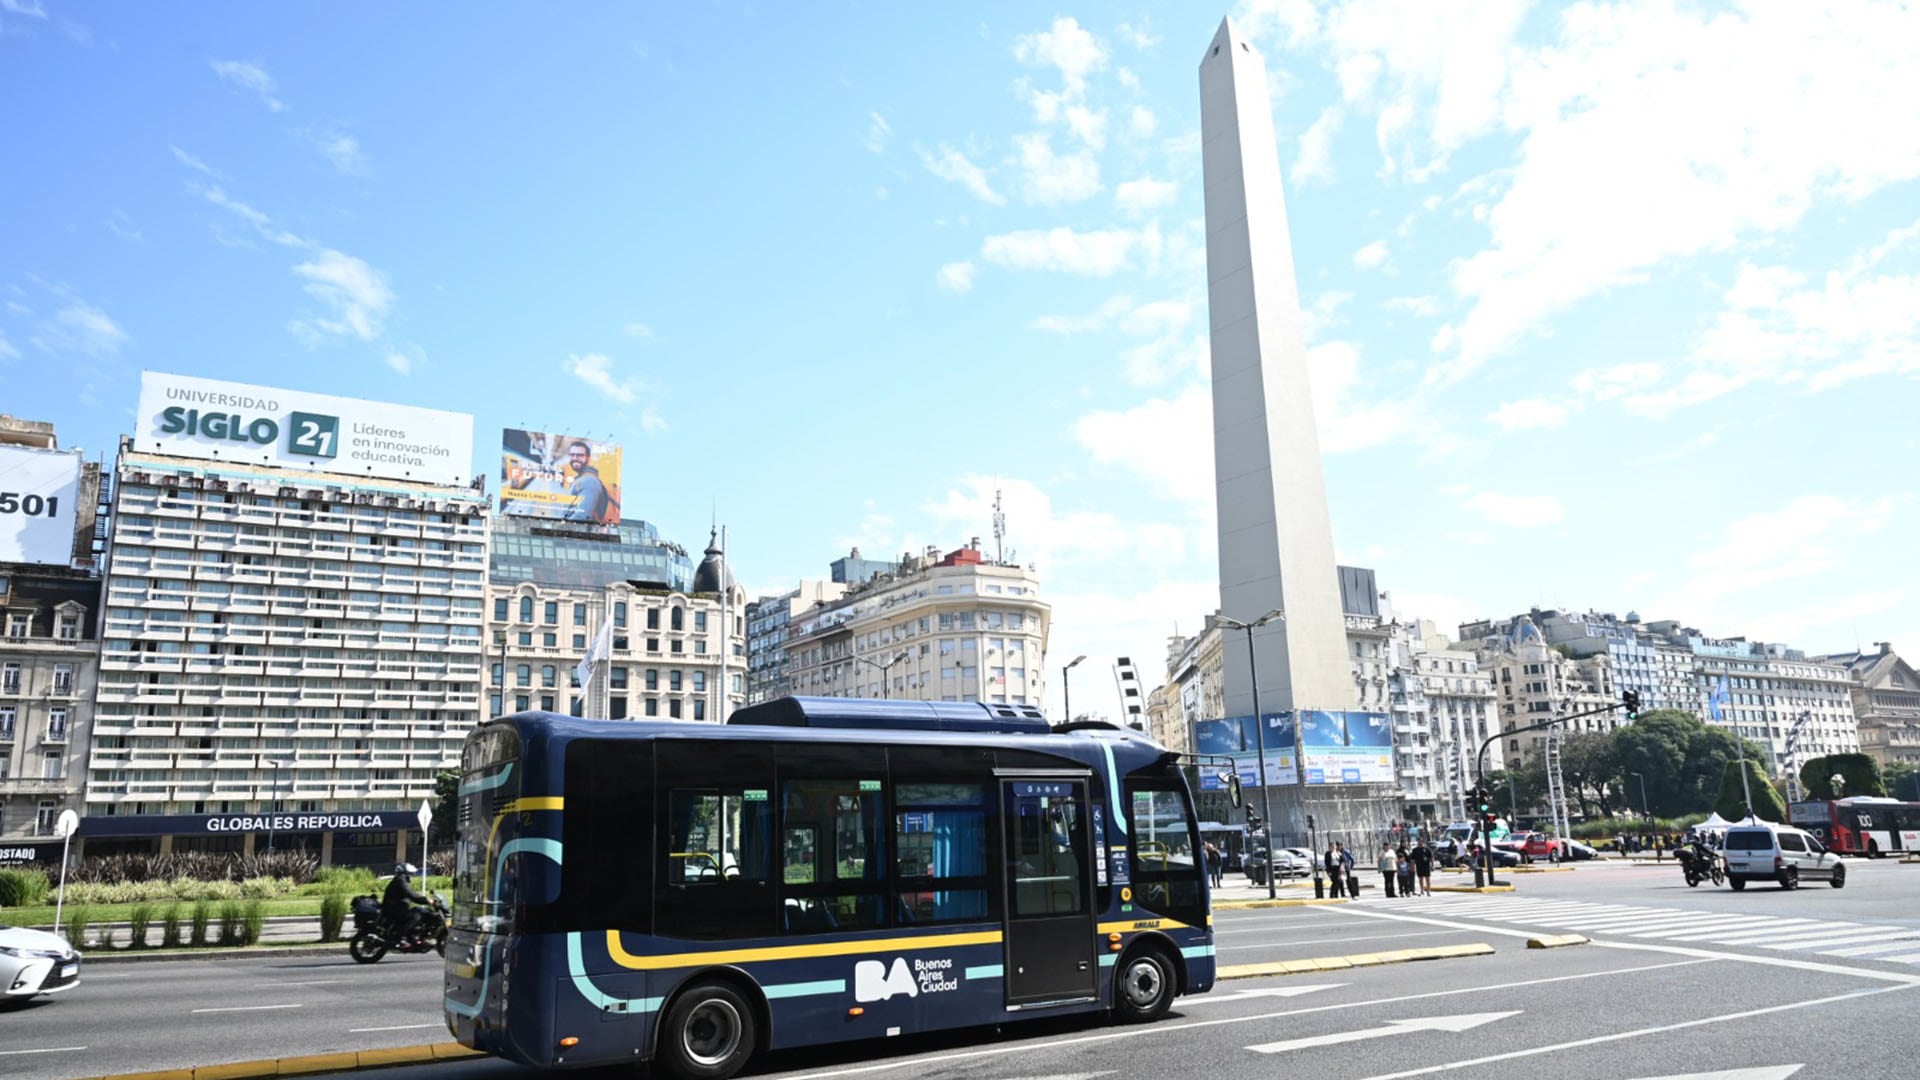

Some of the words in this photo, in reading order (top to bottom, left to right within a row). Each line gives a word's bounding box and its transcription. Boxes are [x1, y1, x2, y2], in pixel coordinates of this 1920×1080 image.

[166, 387, 279, 412] UNIVERSIDAD
[161, 406, 279, 445] SIGLO
[296, 421, 332, 456] 21
[353, 423, 406, 439] Líderes
[352, 438, 370, 447] en
[374, 438, 450, 457] innovación
[351, 450, 425, 467] educativa.
[0, 492, 58, 518] 501
[207, 817, 294, 831] GLOBALES
[298, 814, 382, 829] REPÚBLICA
[915, 959, 953, 971] Buenos
[855, 957, 918, 1003] BA
[918, 970, 944, 982] Aires
[921, 978, 957, 993] Ciudad
